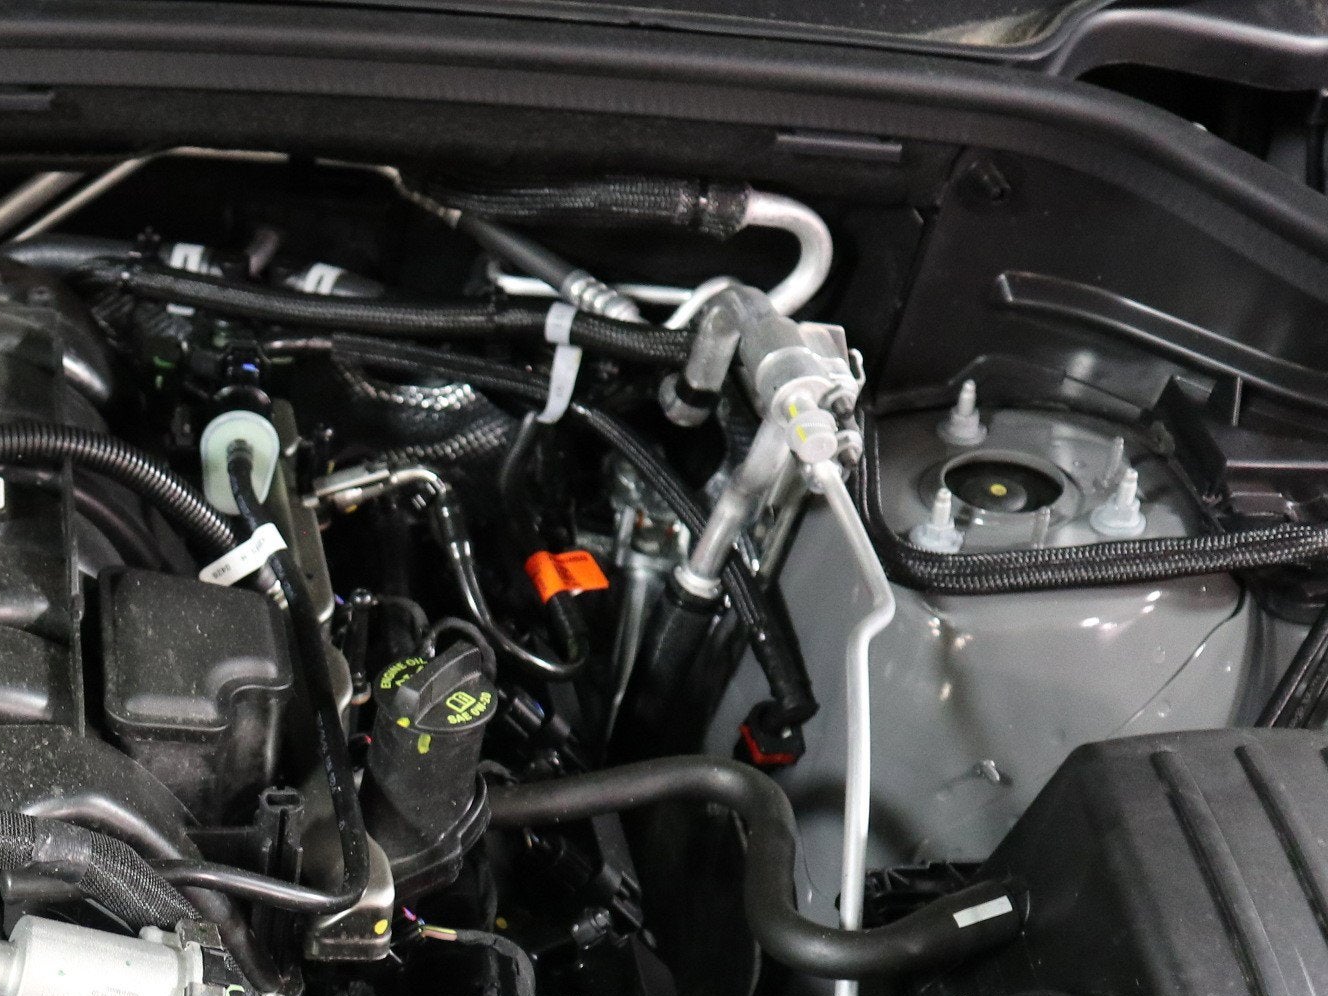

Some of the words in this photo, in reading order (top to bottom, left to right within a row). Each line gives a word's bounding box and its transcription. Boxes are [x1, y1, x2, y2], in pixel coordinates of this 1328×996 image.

[380, 662, 407, 689] ENGINE
[405, 656, 428, 667] OIL
[446, 711, 473, 725] SAE
